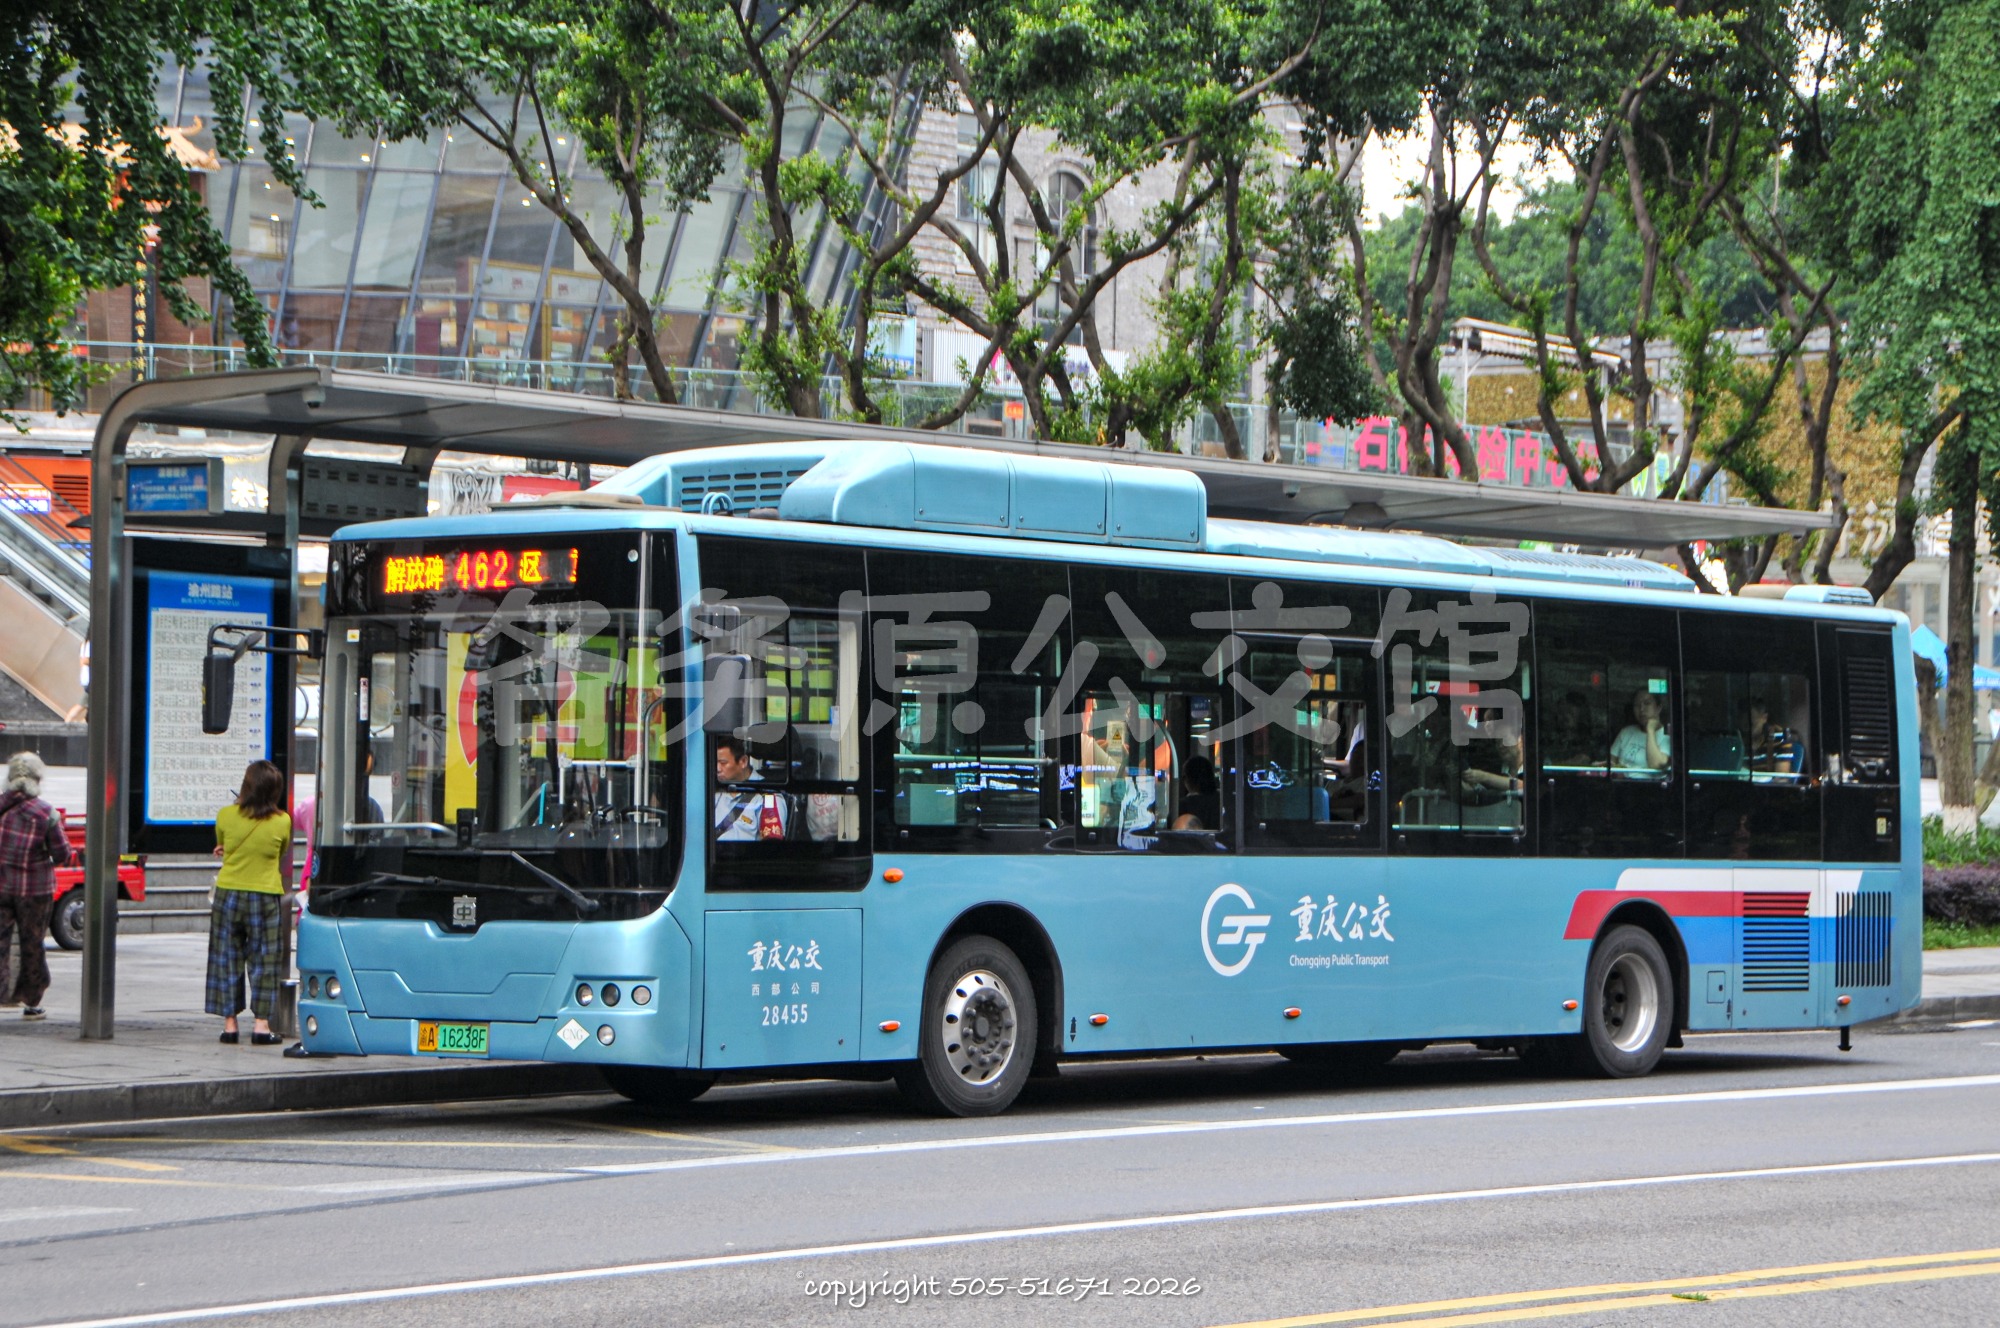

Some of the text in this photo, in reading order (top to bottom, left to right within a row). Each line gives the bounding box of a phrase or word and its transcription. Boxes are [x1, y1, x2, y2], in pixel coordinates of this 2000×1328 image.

[384, 555, 444, 593] 解放碑
[456, 550, 509, 589] 462
[1290, 895, 1394, 942] 重庆公交
[747, 940, 823, 971] 重庆公交
[1289, 953, 1389, 968] Chongqing Public Transport
[751, 982, 820, 996] 西部公司
[762, 1003, 808, 1026] 28455
[562, 1029, 583, 1041] CNG
